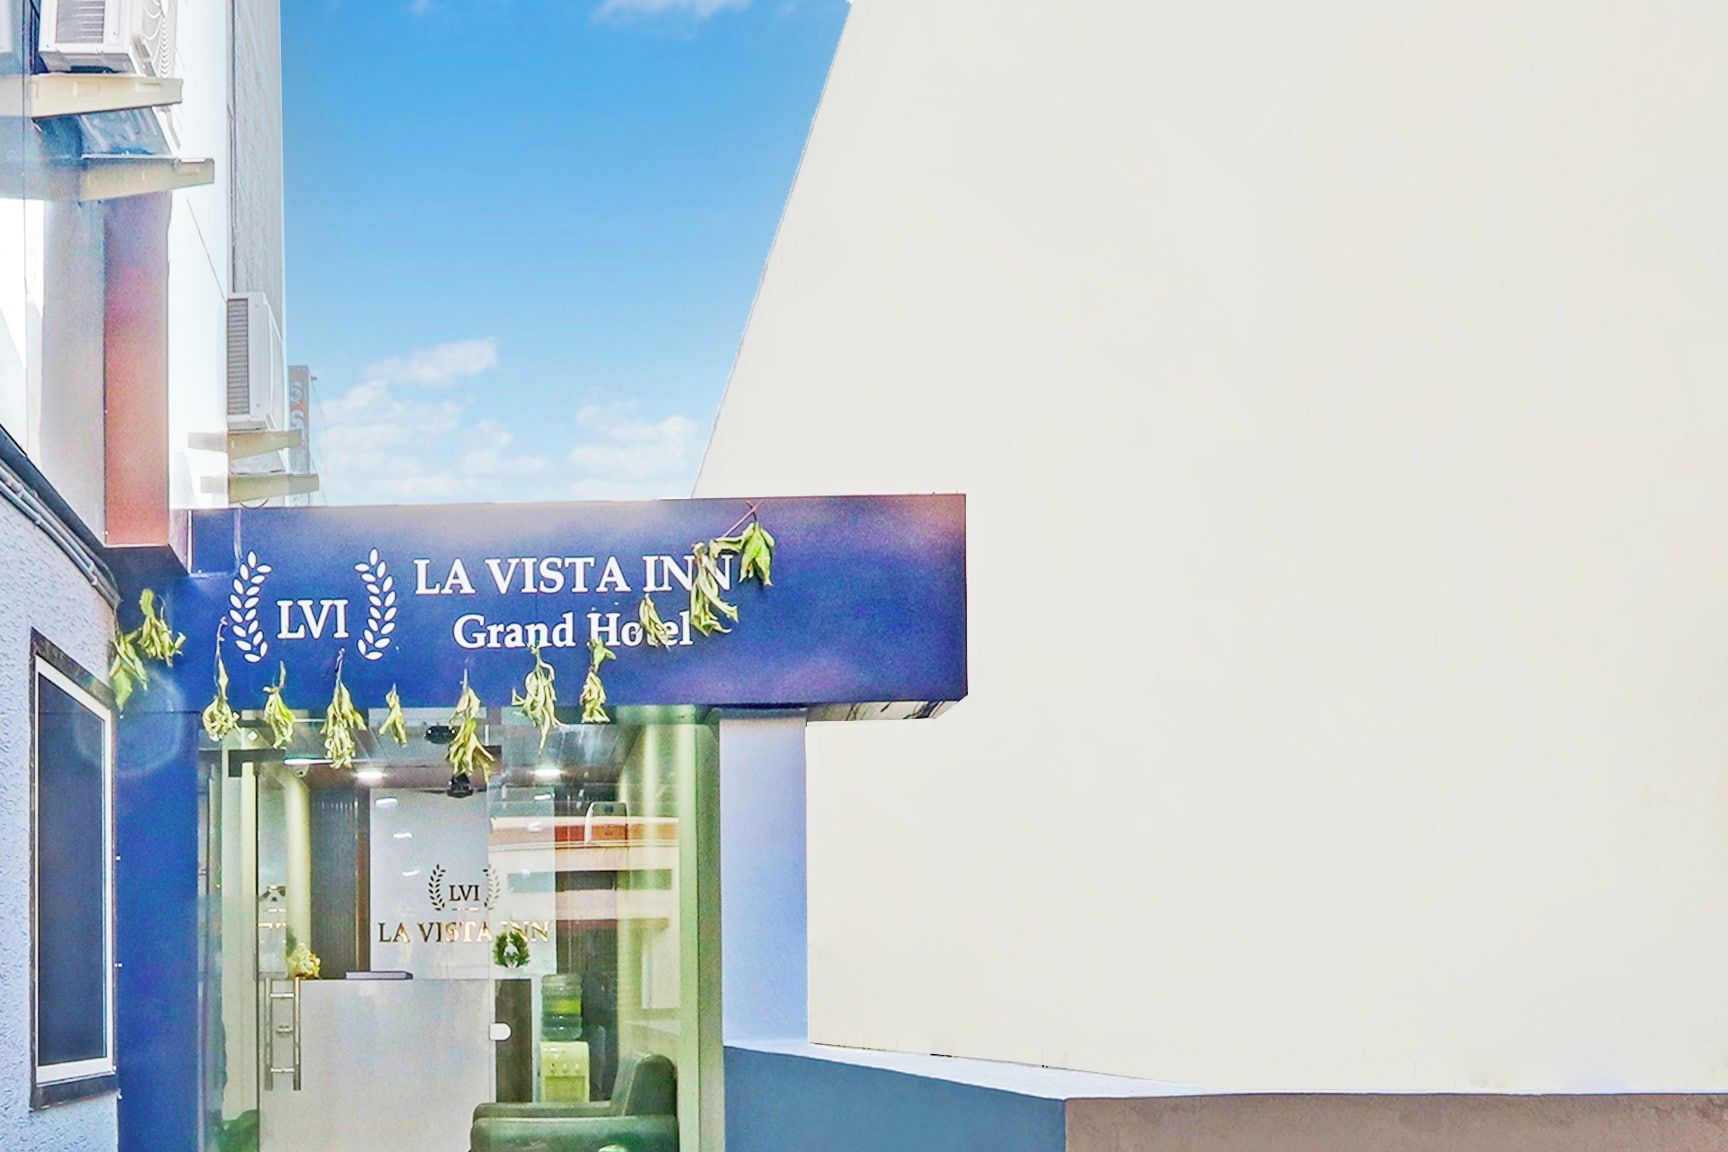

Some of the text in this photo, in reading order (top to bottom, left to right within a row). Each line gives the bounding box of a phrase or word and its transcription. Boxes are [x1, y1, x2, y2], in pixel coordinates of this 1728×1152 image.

[414, 554, 734, 594] LA VISTA INN
[276, 600, 349, 639] LVI
[453, 611, 693, 648] Grand Hoel
[449, 885, 480, 901] LVI
[378, 920, 550, 943] LA VISTA NN
